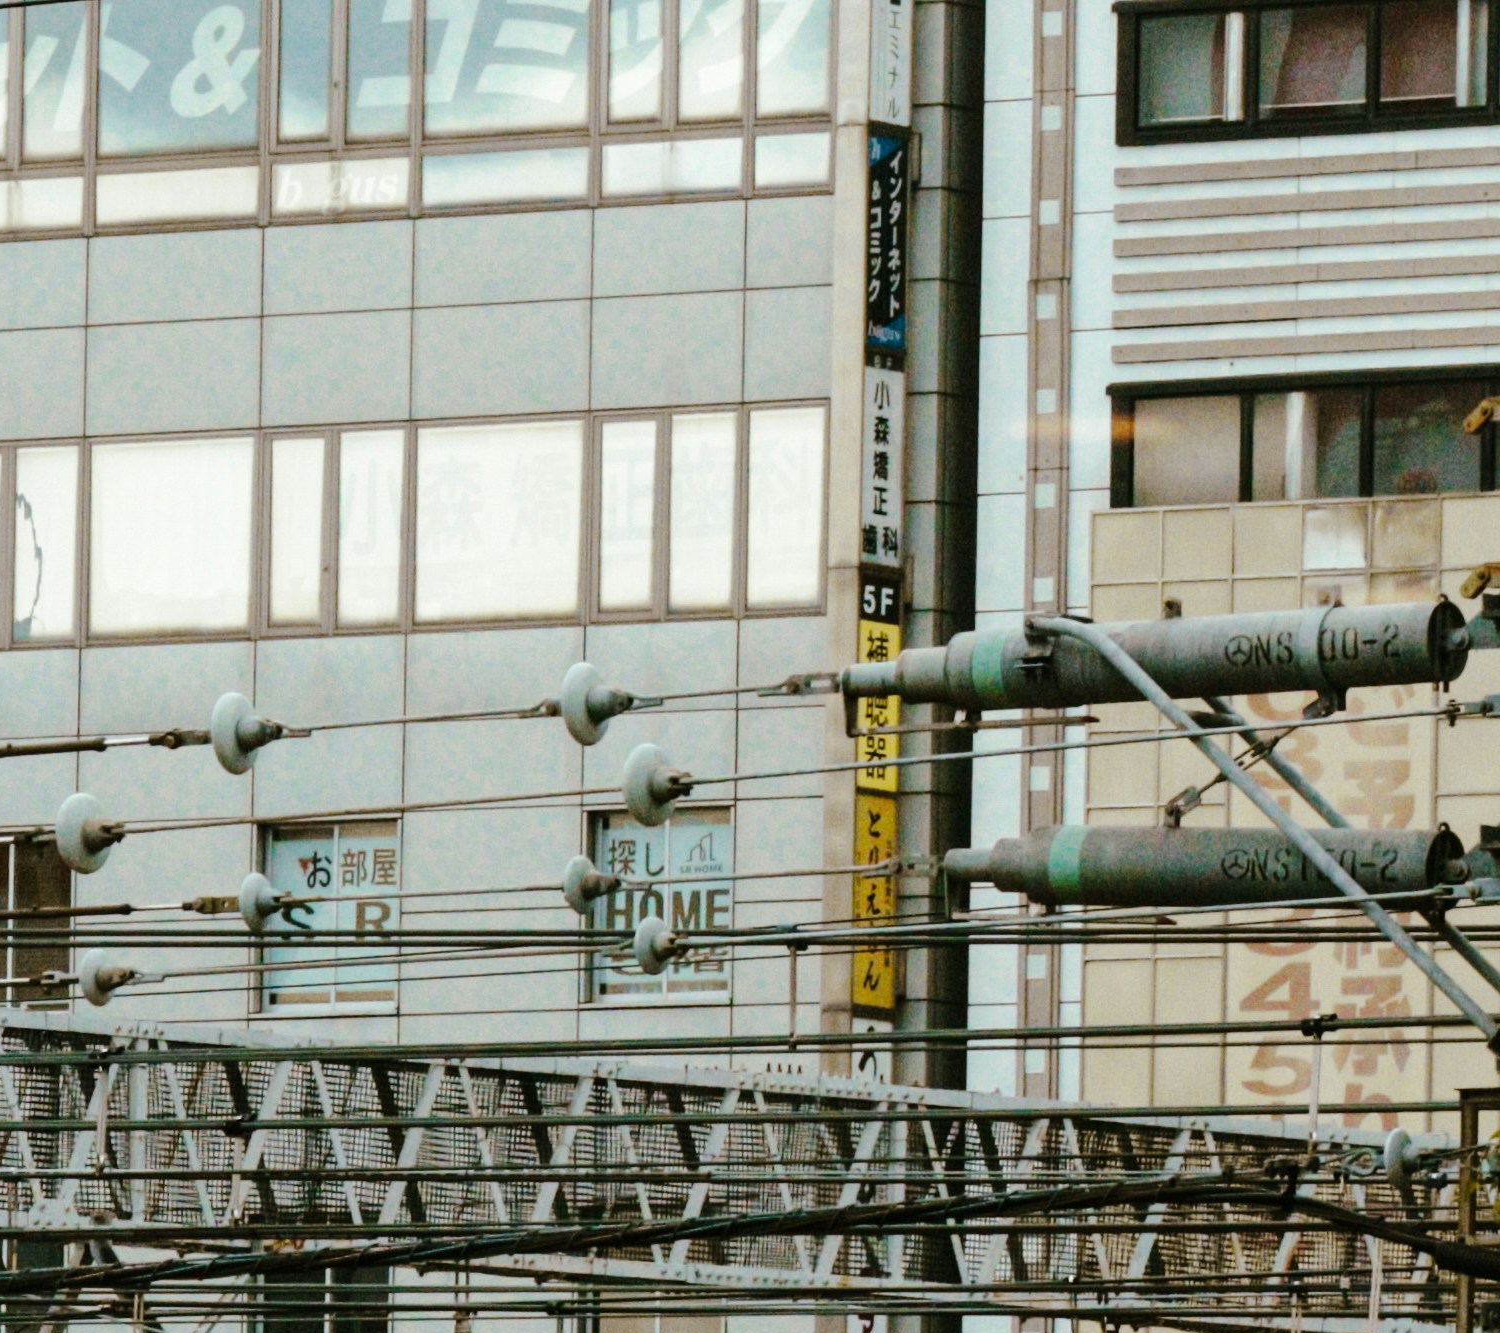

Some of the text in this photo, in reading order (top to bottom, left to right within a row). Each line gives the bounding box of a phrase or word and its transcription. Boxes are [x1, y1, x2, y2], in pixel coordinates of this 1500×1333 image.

[862, 585, 895, 618] 5F
[305, 848, 398, 889] お部屋
